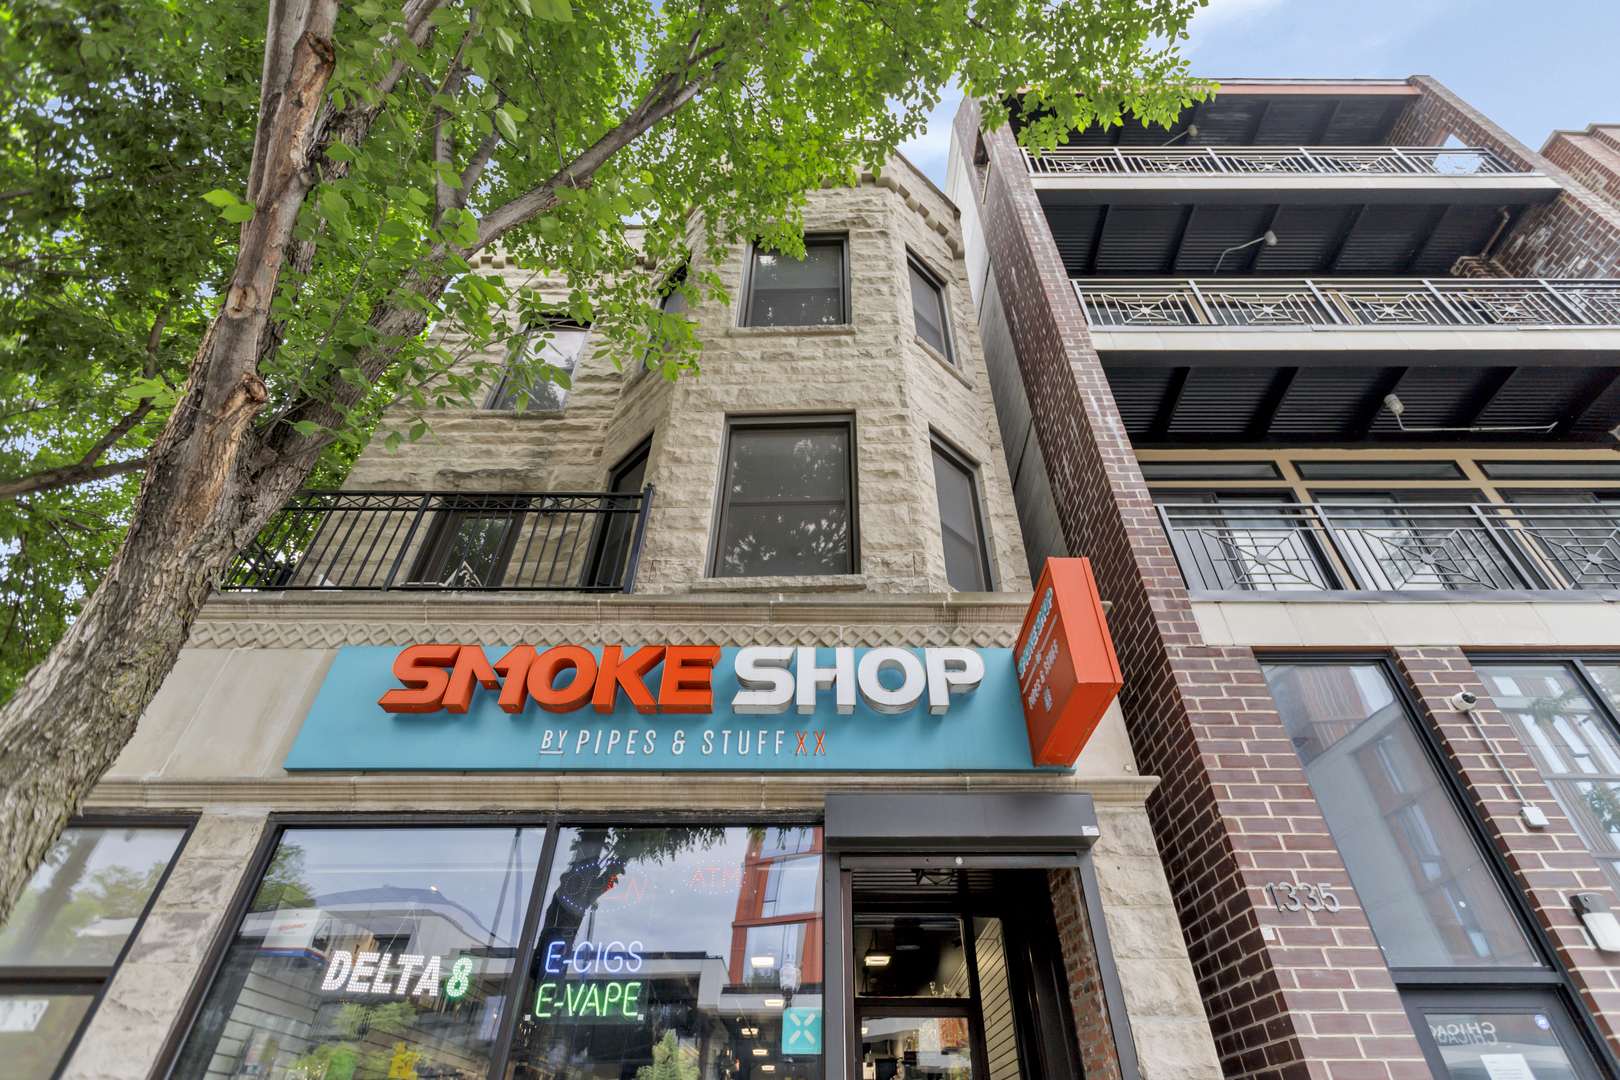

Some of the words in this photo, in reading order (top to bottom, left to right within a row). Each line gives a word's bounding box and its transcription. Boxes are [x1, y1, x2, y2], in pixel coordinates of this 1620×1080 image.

[377, 643, 722, 714] SMOKE
[731, 645, 985, 715] SHOP
[541, 729, 568, 752] BY
[575, 729, 656, 755] PIPES
[671, 729, 686, 755] &
[701, 729, 786, 756] STUFF
[689, 866, 741, 888] ATM
[1265, 881, 1341, 913] 1335
[544, 940, 644, 973] E-CIGS
[321, 950, 441, 997] DELTA
[445, 957, 474, 998] 8
[535, 981, 642, 1018] E-VAPE
